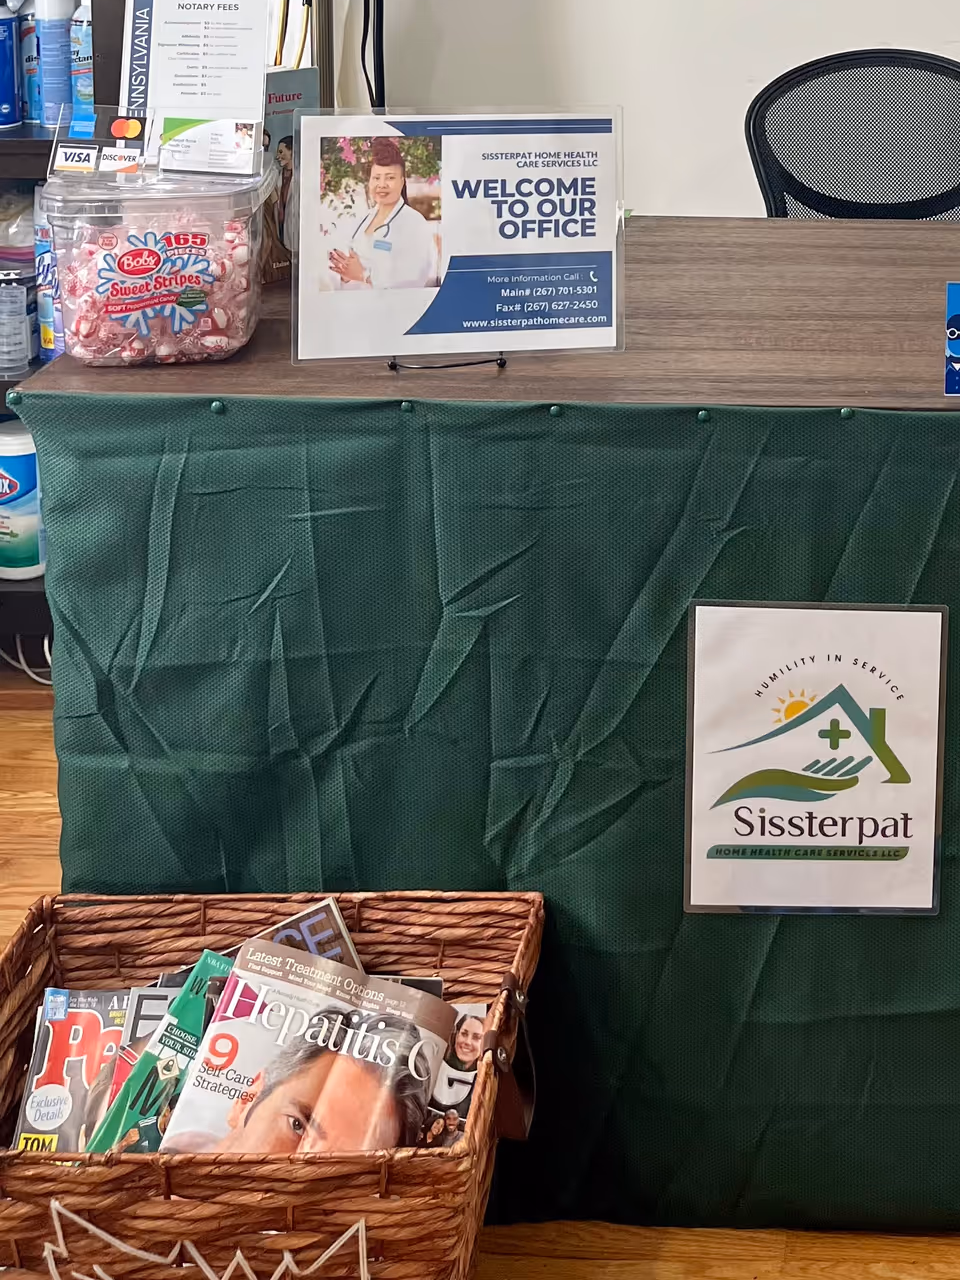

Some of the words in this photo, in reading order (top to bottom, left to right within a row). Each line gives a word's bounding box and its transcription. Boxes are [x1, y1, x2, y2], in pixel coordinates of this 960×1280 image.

[268, 92, 302, 104] Future
[63, 151, 90, 163] VISA
[102, 154, 137, 162] DISCOVER
[481, 152, 533, 161] SISSTERPAT
[534, 152, 562, 160] HOME
[563, 151, 598, 159] HEALTH
[516, 160, 539, 168] CARE
[541, 160, 581, 168] SERVICES
[452, 177, 596, 199] WELCOME
[491, 199, 529, 219] TO
[536, 198, 596, 217] OUR
[499, 219, 596, 239] OFFICE
[161, 233, 208, 248] 165
[166, 247, 206, 257] PIECES
[110, 281, 152, 297] Sweet
[153, 274, 201, 290] Stripes
[487, 275, 510, 283] More
[511, 274, 561, 283] Information
[501, 288, 531, 297] Main#
[533, 287, 556, 297] (267)
[557, 286, 597, 295] 701-5301
[496, 302, 522, 313] Fax#
[524, 302, 549, 312] (267)
[551, 300, 598, 310] 627-2450
[463, 315, 607, 329] www.sissterpathomecare.com
[755, 655, 816, 697] HUMILITY
[827, 654, 842, 662] IN
[853, 658, 904, 701] SERVICE
[734, 806, 914, 846] Sissterpat
[716, 848, 747, 856] HOME
[751, 848, 790, 856] HEALTH
[795, 849, 823, 857] CARE
[826, 849, 878, 857] SERVICES
[247, 947, 282, 967] Latest
[285, 957, 342, 986] Treatment
[343, 978, 385, 1002] Options
[167, 1025, 198, 1045] CHOOSE
[222, 978, 399, 1068] Hepatitis
[408, 1038, 440, 1081] C
[204, 1033, 239, 1072] 9
[198, 1061, 255, 1087] Self-Care
[193, 1075, 255, 1103] Strategies
[30, 1095, 68, 1109] Exclusive
[33, 1107, 64, 1122] Details
[23, 1136, 54, 1152] TOM
